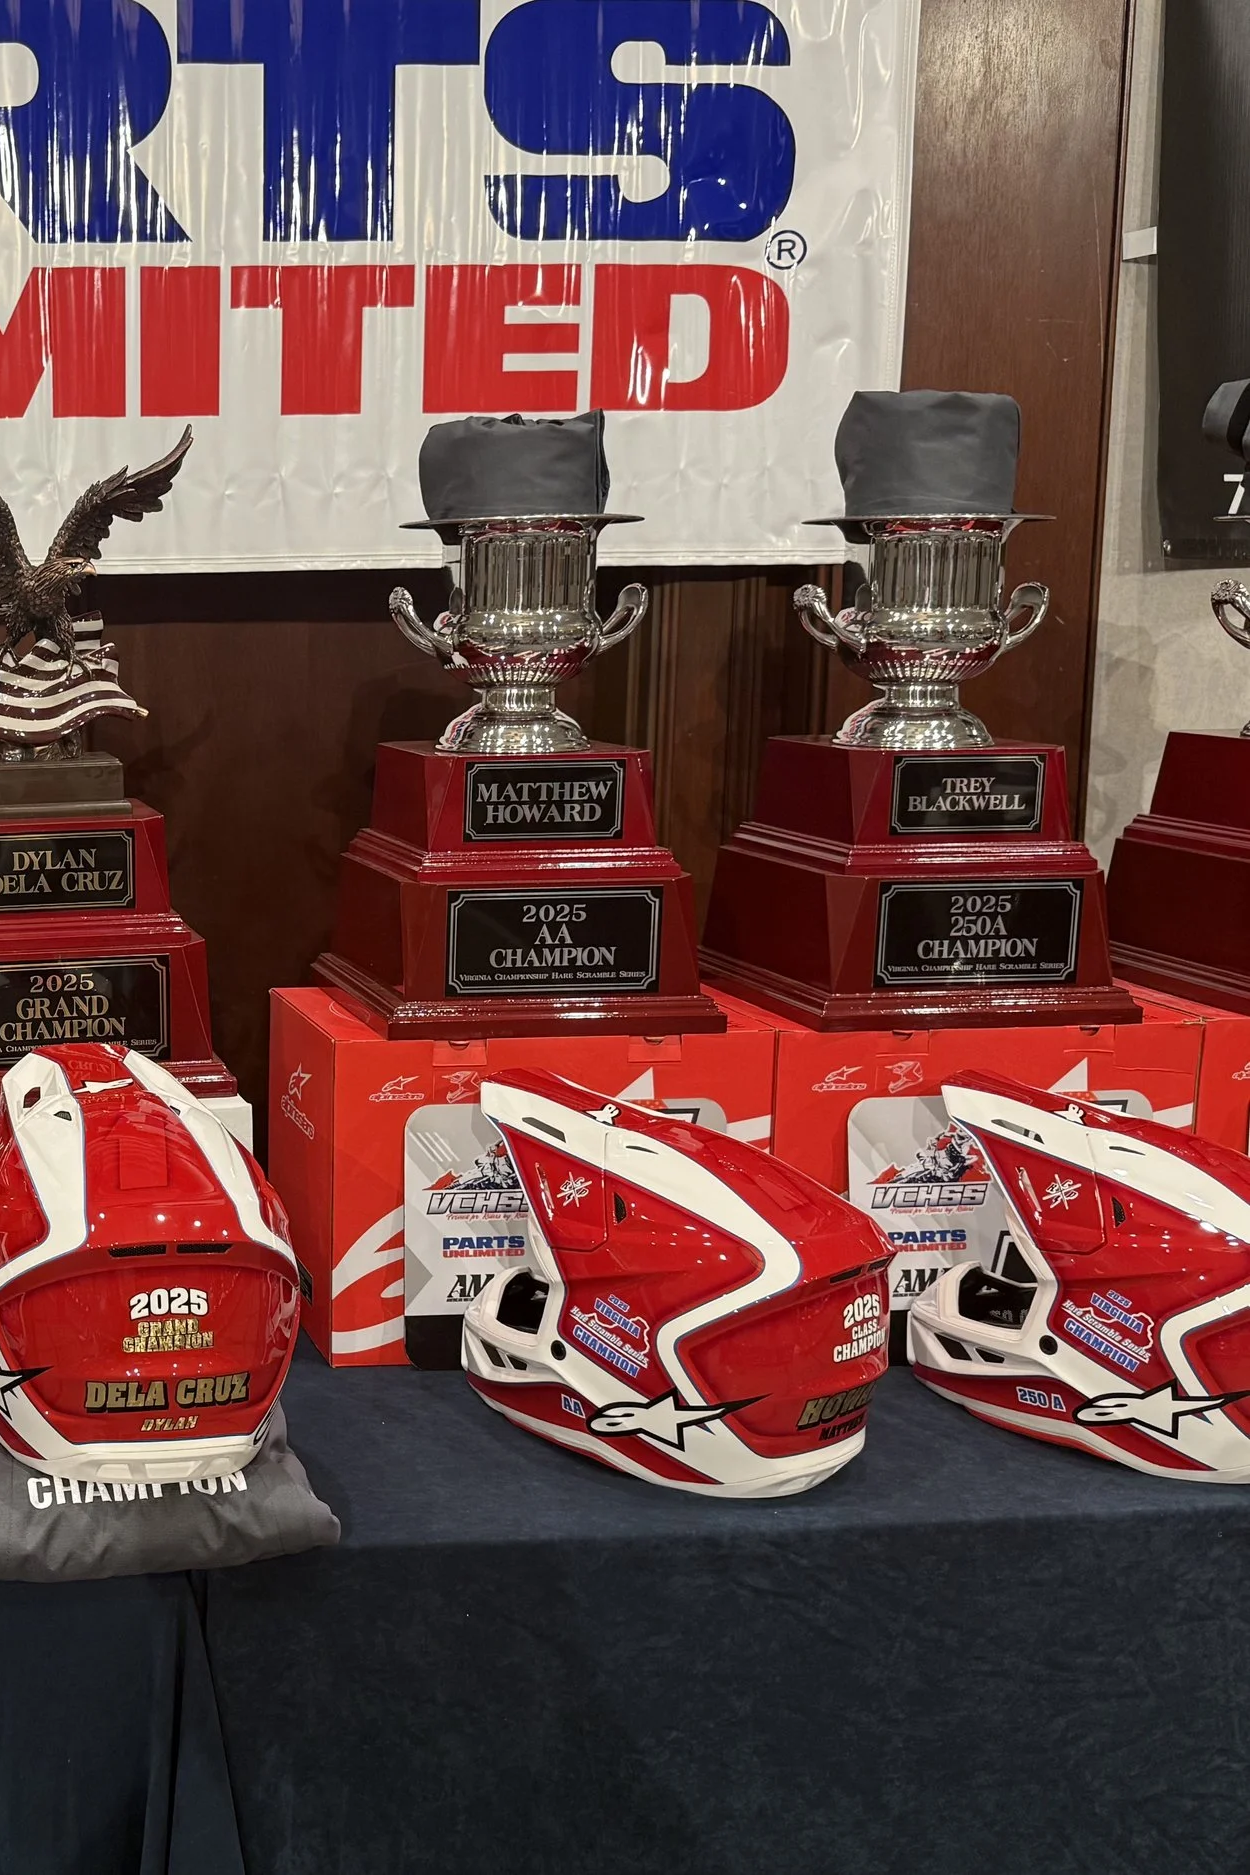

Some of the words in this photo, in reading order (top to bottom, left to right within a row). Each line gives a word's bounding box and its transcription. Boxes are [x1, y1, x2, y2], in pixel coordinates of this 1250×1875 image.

[475, 780, 614, 803] MATTHEW
[941, 776, 996, 794] TREY
[485, 803, 602, 825] HOWARD
[907, 794, 1026, 813] BLACKWELL
[12, 848, 97, 872] DYLAN
[61, 869, 125, 892] CRUZ
[522, 904, 587, 923] 2025
[950, 895, 1012, 914] 2025
[534, 923, 573, 945] AA
[950, 914, 1008, 937] 250A
[489, 946, 617, 968] CHAMPION
[917, 937, 1038, 959] CHAMPION
[29, 973, 95, 993] 2025
[16, 995, 109, 1020] GRAND
[0, 1017, 126, 1042] CHAMPION
[427, 1191, 529, 1215] VCHS
[871, 1183, 989, 1209] VCHSS
[442, 1235, 525, 1250] PARTS
[888, 1229, 967, 1243] PARTS
[442, 1248, 525, 1258] UNLIMITED
[129, 1287, 208, 1320] 2025
[843, 1294, 880, 1329] 2025
[1090, 1292, 1144, 1335] VIRGINIA
[137, 1319, 199, 1337] GRAND
[594, 1297, 641, 1339] VIRGINIA
[852, 1318, 878, 1340] CLASS
[122, 1331, 214, 1353] CHAMPION
[573, 1324, 640, 1378] CHAMPION
[833, 1326, 886, 1363] CHAMPION
[1063, 1318, 1140, 1373] CHAMPION
[84, 1380, 169, 1412] DELA
[175, 1372, 250, 1410] CRUZ
[1016, 1386, 1048, 1408] 250
[1051, 1393, 1066, 1412] A
[561, 1393, 585, 1418] AA
[141, 1415, 198, 1432] DYLAN
